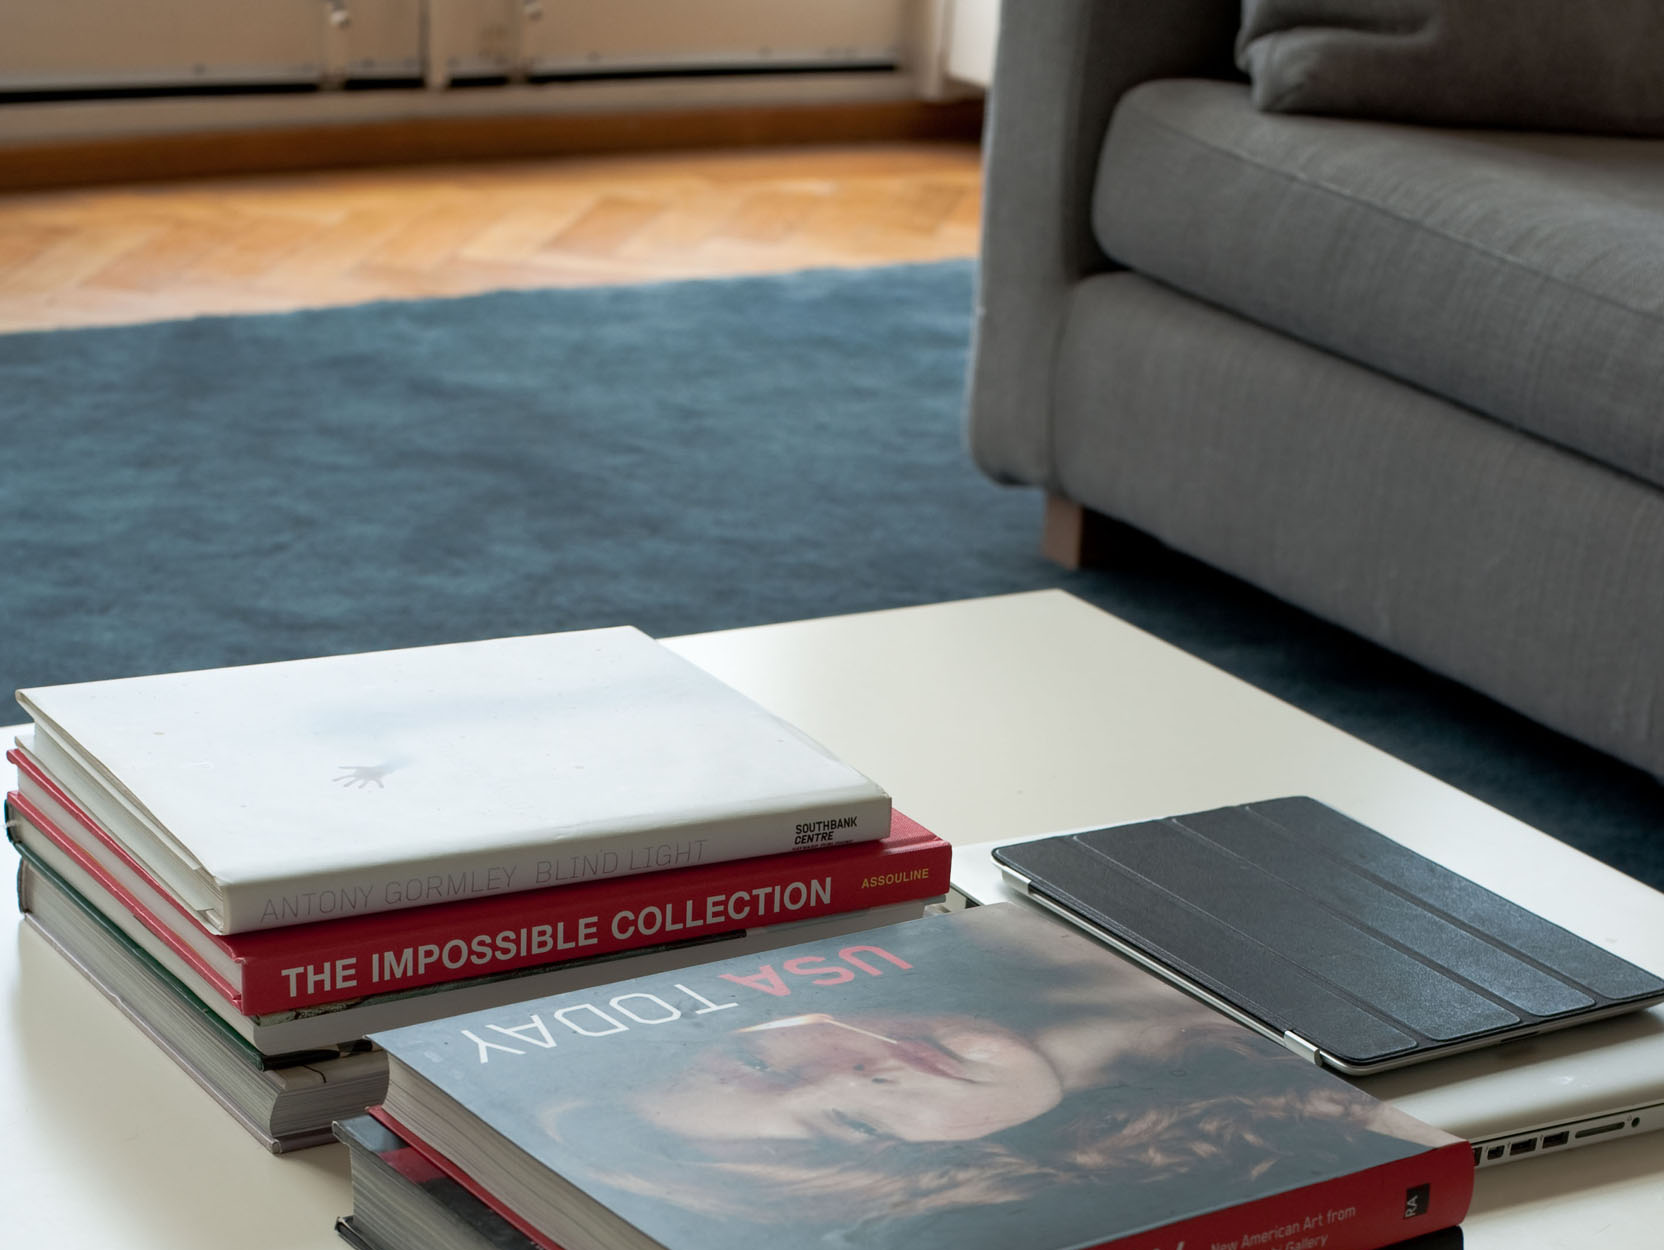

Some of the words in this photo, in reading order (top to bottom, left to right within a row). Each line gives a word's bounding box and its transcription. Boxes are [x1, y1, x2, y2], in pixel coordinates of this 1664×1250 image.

[794, 831, 834, 845] CENTRE
[795, 816, 858, 834] SOUTHBANK
[259, 884, 375, 924] ANTONY
[383, 864, 518, 906] GORMLEY
[535, 848, 619, 884] BLIND
[628, 838, 709, 871] LIGHT
[861, 868, 929, 889] ASSOULINE
[280, 956, 358, 999] THE
[371, 915, 599, 983] IMPOSSIBLE
[610, 875, 833, 941] COLLECTION
[717, 944, 914, 997] USA
[459, 983, 739, 1065] TODAY
[1240, 1221, 1300, 1249] American
[1303, 1214, 1323, 1231] Art
[1327, 1205, 1357, 1225] from
[1404, 1194, 1419, 1218] RA
